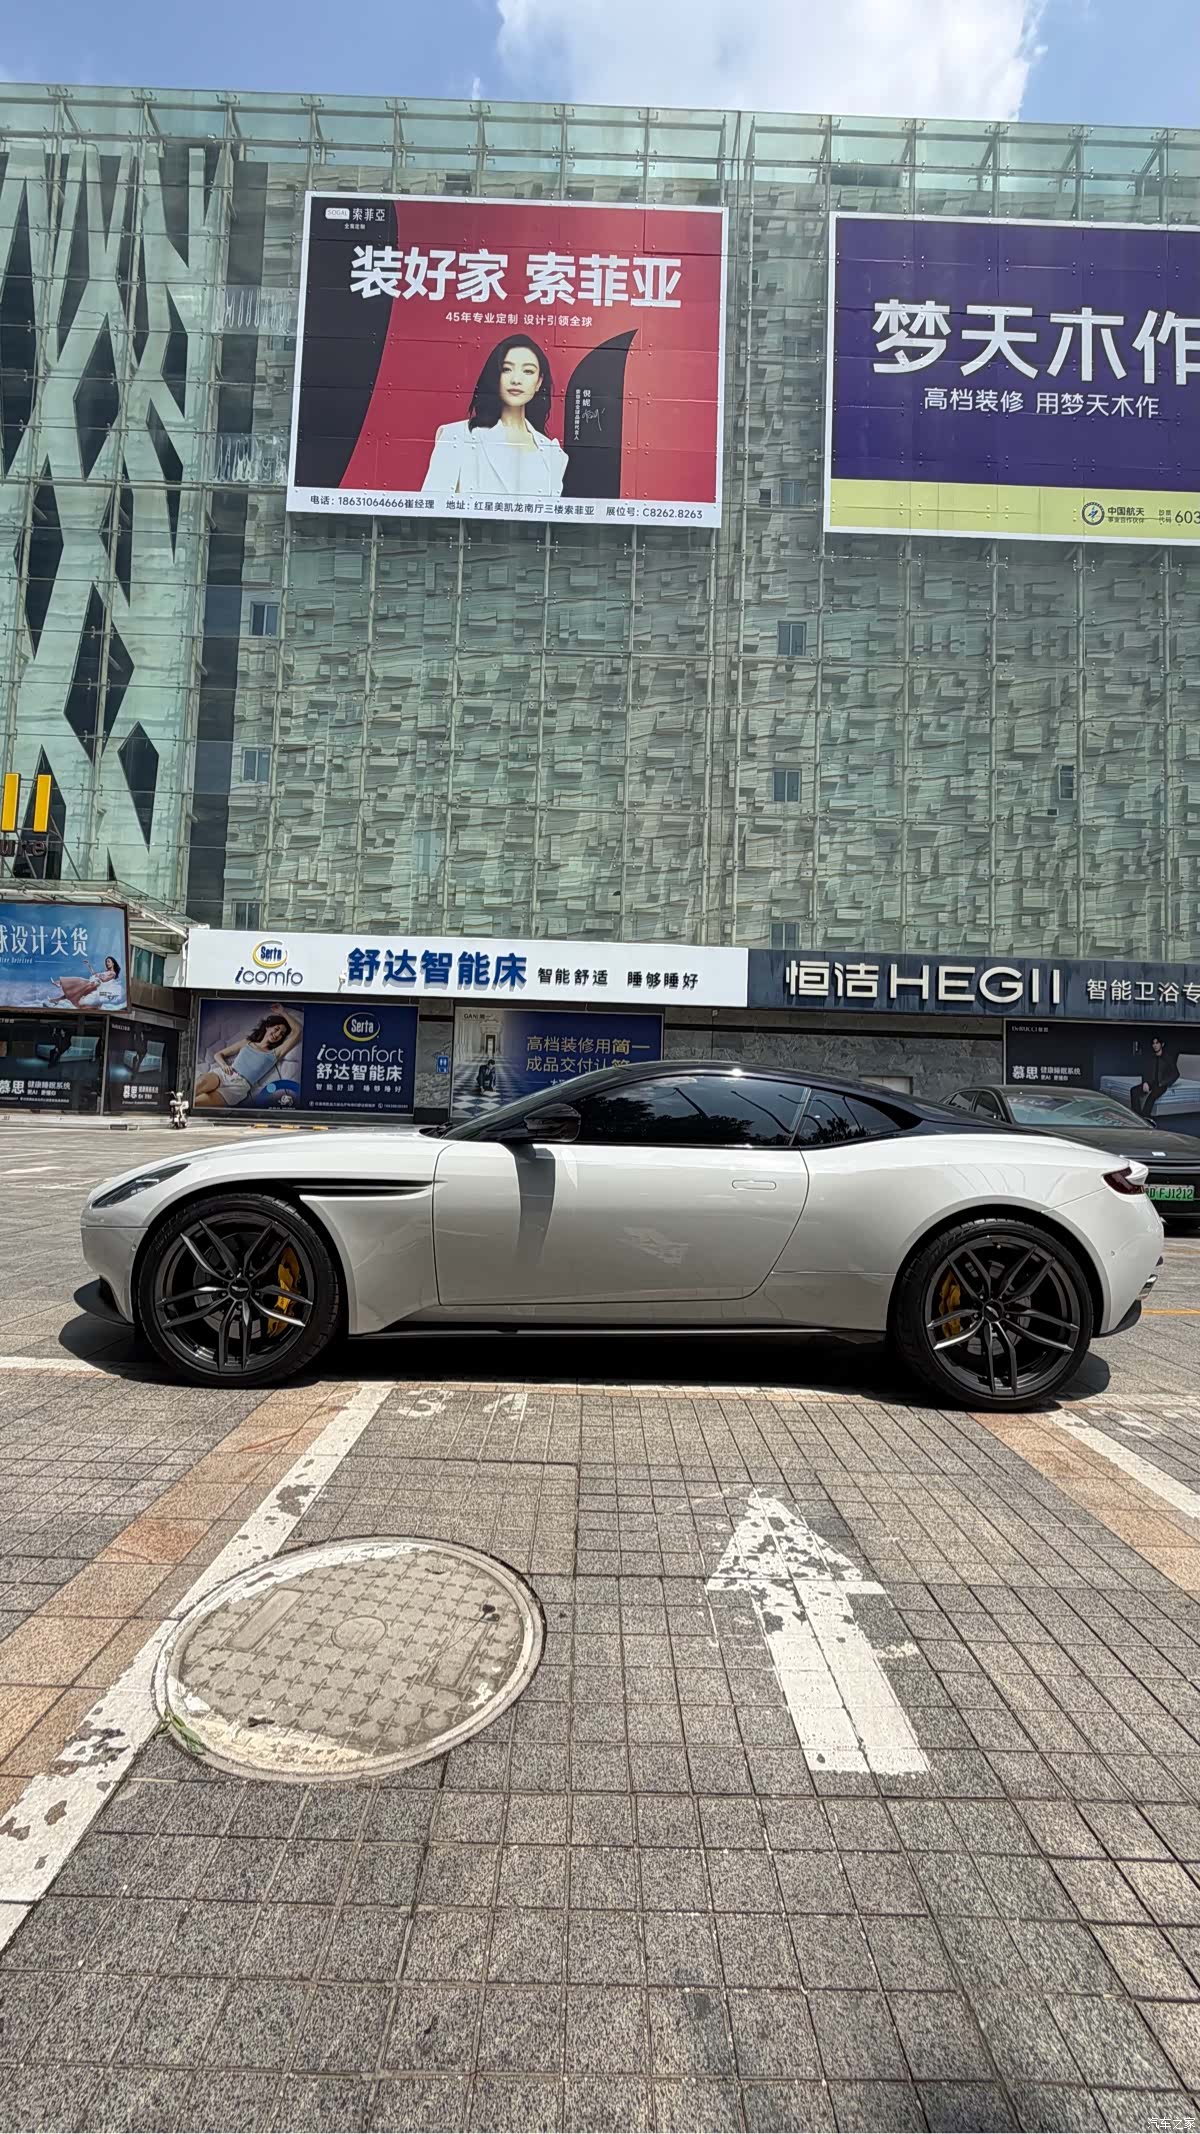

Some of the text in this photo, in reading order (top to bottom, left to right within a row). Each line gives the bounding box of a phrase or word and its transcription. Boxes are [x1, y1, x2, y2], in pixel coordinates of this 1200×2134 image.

[352, 208, 386, 222] 索菲亞
[350, 245, 682, 309] 装好家 索菲亚
[445, 311, 593, 328] 45年专业定制 设计引领全球
[872, 298, 1200, 385] 梦天木作
[923, 387, 1160, 419] 高档装修 用梦天木作
[1107, 506, 1145, 516] 中国航天
[260, 945, 282, 961] Serta
[234, 966, 304, 986] icomfo
[347, 947, 699, 990] 舒达智能床 智能舒适 睡够睡好
[785, 960, 1200, 1004] 恒洁 HEGII 智能卫浴专
[351, 1018, 374, 1033] Serta
[316, 1044, 404, 1063] icomfort
[526, 1034, 651, 1055] 高档装修用简一
[316, 1063, 403, 1082] 舒达智能床
[1012, 1065, 1039, 1080] 慕思
[315, 1083, 355, 1092] 智能舒适
